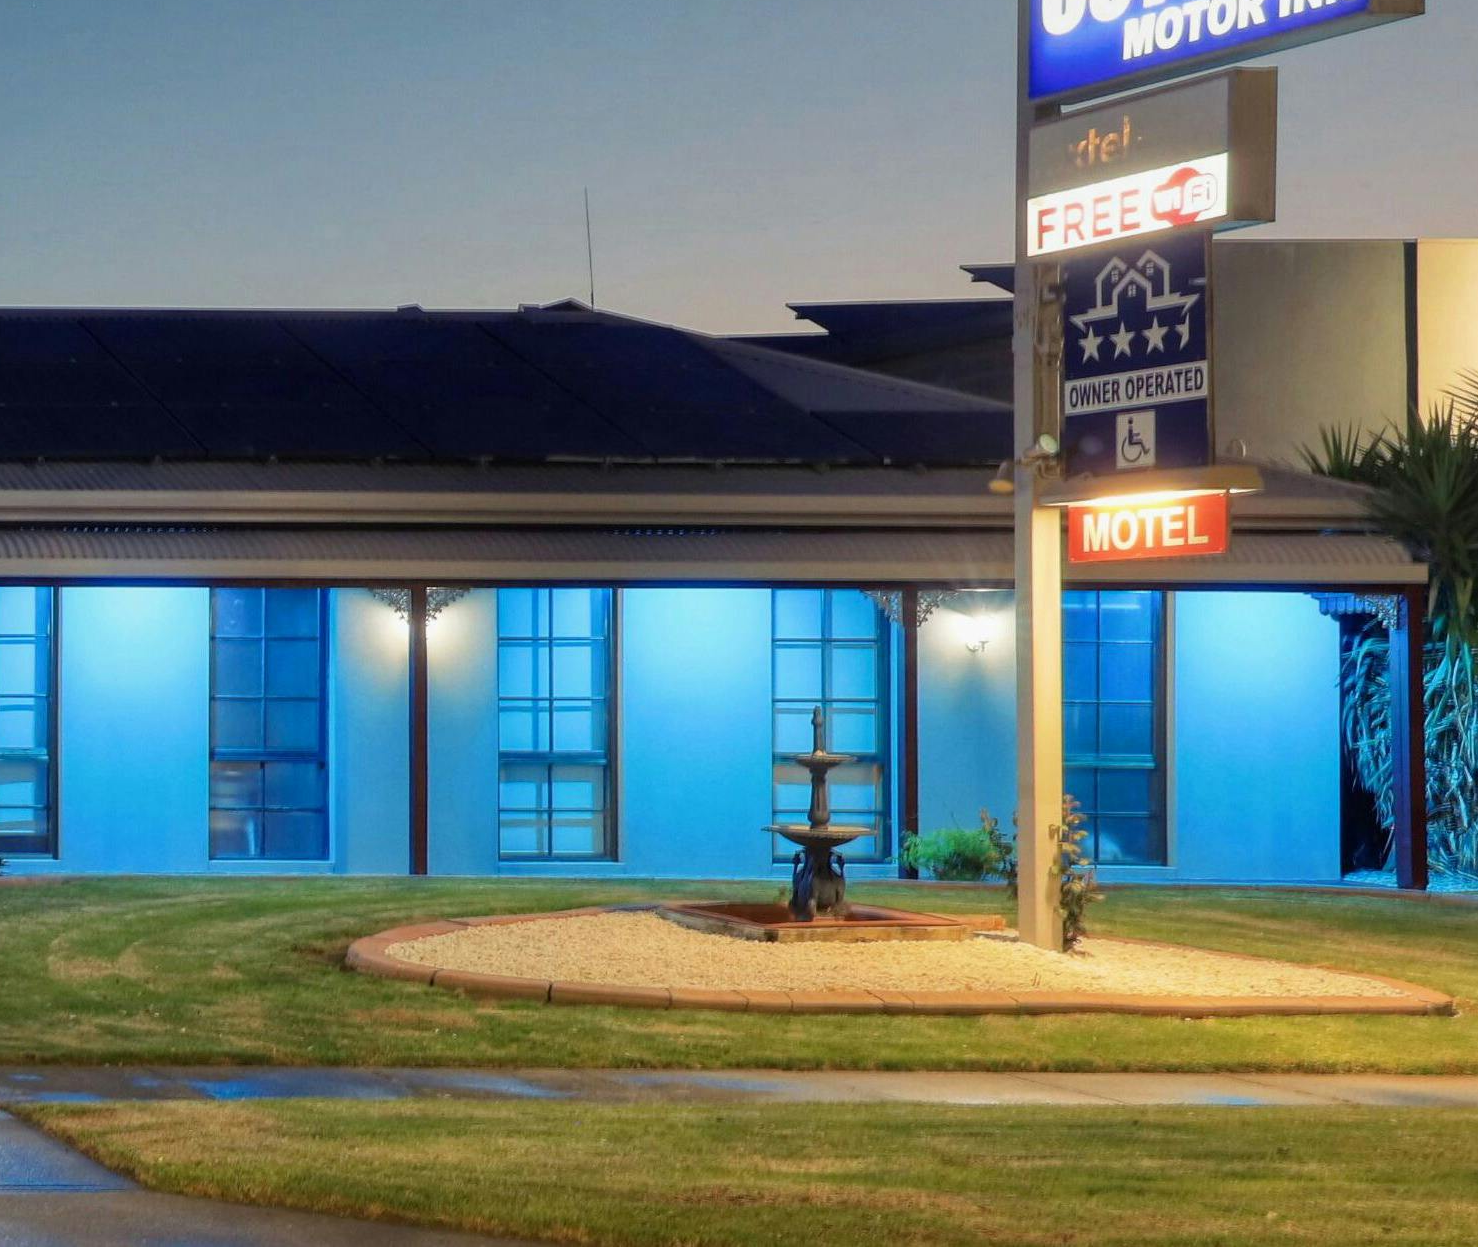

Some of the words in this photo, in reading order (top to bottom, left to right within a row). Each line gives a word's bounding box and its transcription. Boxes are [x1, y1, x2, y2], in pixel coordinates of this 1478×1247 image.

[1037, 189, 1141, 250] FREE
[1069, 378, 1121, 408] OWNER
[1125, 366, 1204, 400] OPERATED
[1082, 505, 1210, 552] MOTEL
